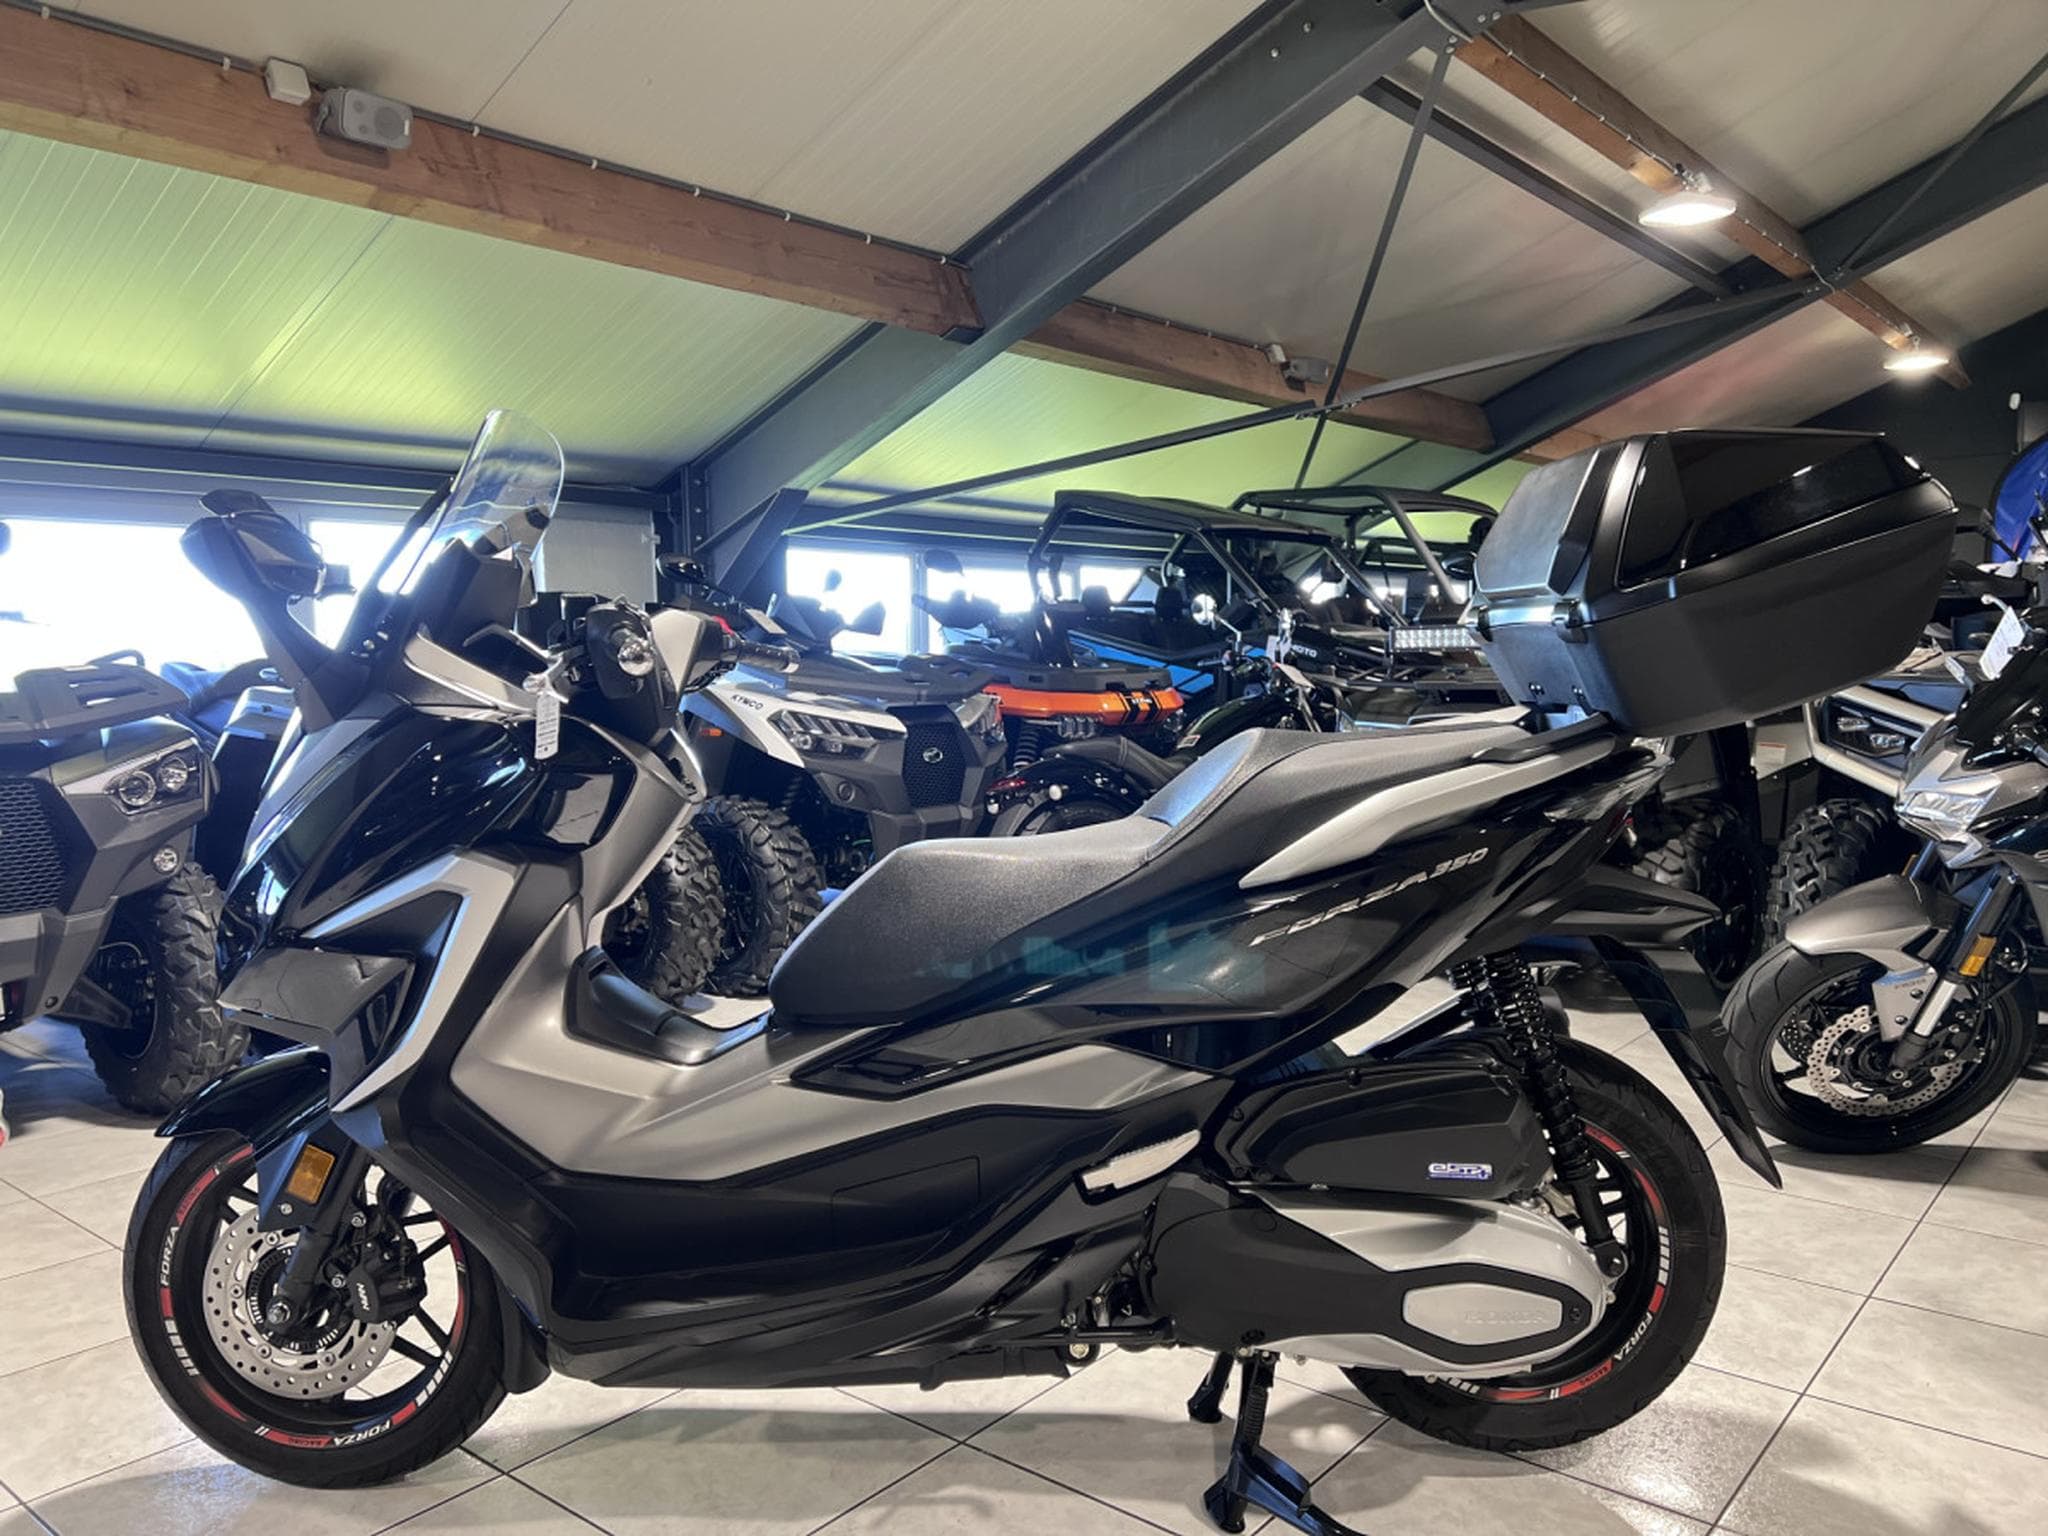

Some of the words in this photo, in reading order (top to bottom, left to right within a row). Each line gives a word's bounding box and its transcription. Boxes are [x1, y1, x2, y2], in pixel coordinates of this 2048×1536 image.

[1249, 871, 1428, 946] FORZA
[1427, 847, 1489, 879] 350
[160, 1226, 180, 1287] FORZA
[1613, 1311, 1654, 1360] FORZA
[333, 1419, 391, 1447] FORZA
